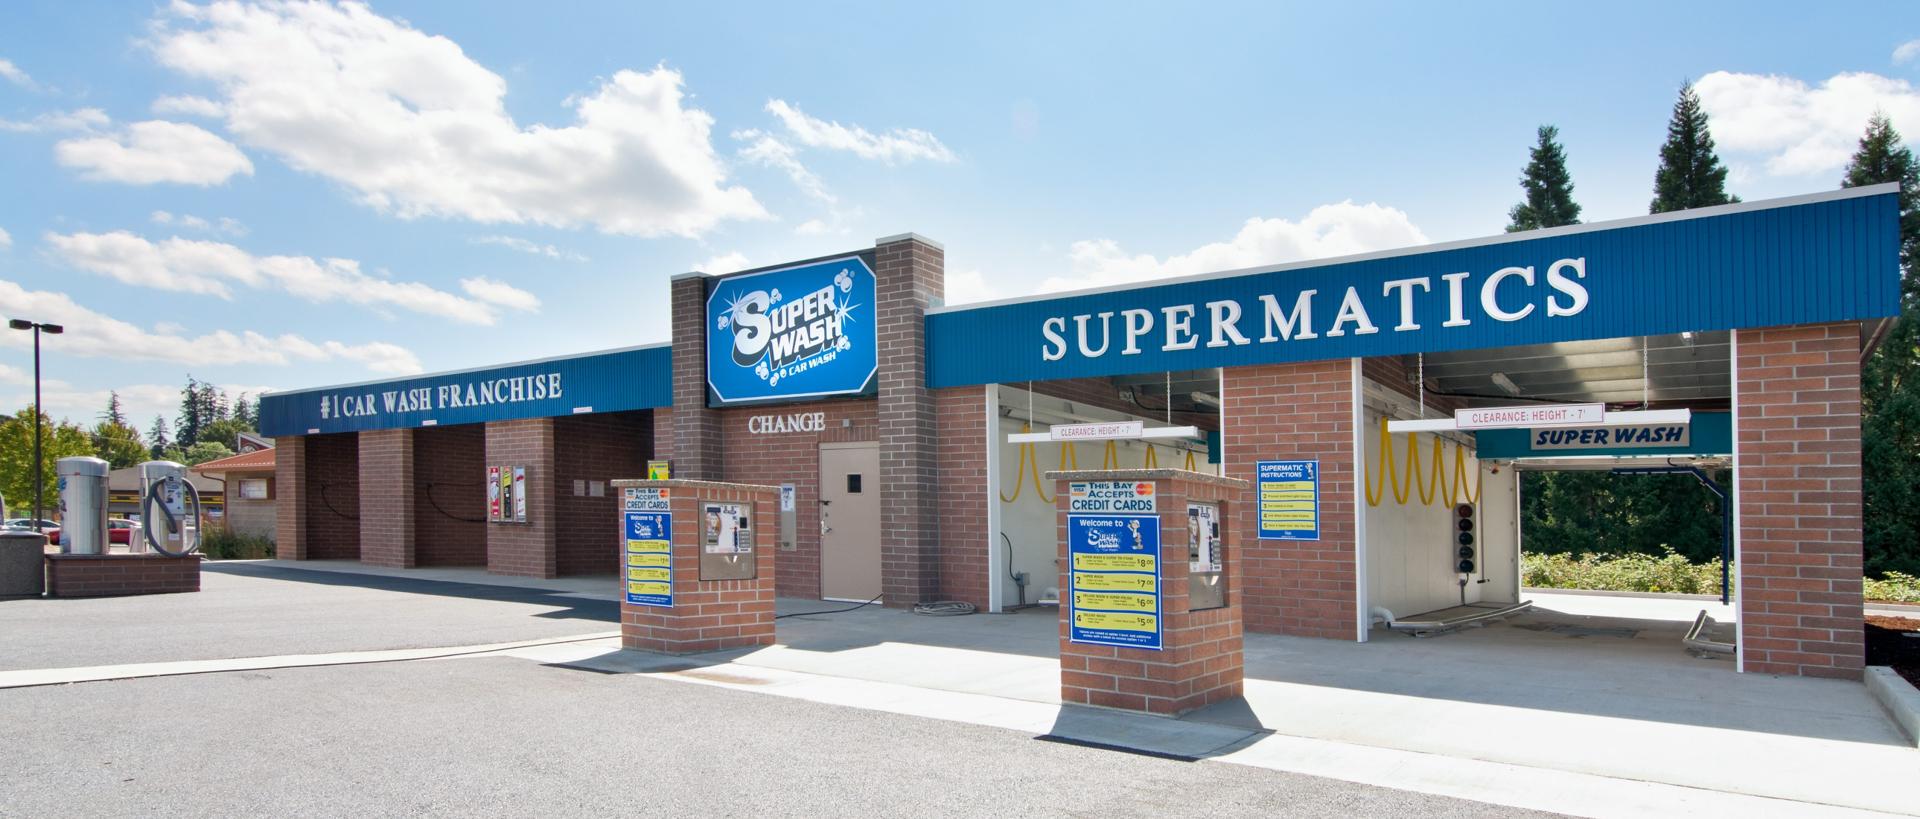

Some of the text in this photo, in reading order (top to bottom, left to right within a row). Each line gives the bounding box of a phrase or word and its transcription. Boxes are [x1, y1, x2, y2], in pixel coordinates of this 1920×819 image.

[1042, 256, 1589, 361] SUPERMATICS
[732, 285, 837, 355] SUPER
[770, 314, 842, 361] WASH
[788, 352, 836, 376] CAR WASH
[320, 372, 562, 419] #1 CAR WASH FRANCHISE
[1472, 411, 1529, 423] CLEARANCE:
[1532, 409, 1567, 421] HEIGHT
[748, 412, 826, 434] CHANGE
[1061, 428, 1097, 437] CLEARANCE:
[1098, 426, 1120, 435] HEIGHT
[1536, 426, 1684, 445] SUPER WASH
[1088, 490, 1134, 498] ACCEPTS
[648, 501, 668, 509] CARDS
[1072, 500, 1152, 511] CREDIT CARDS
[1079, 519, 1113, 527] Welcome
[1076, 557, 1080, 565] 1
[1076, 576, 1081, 584] 2
[1076, 595, 1081, 603] 3
